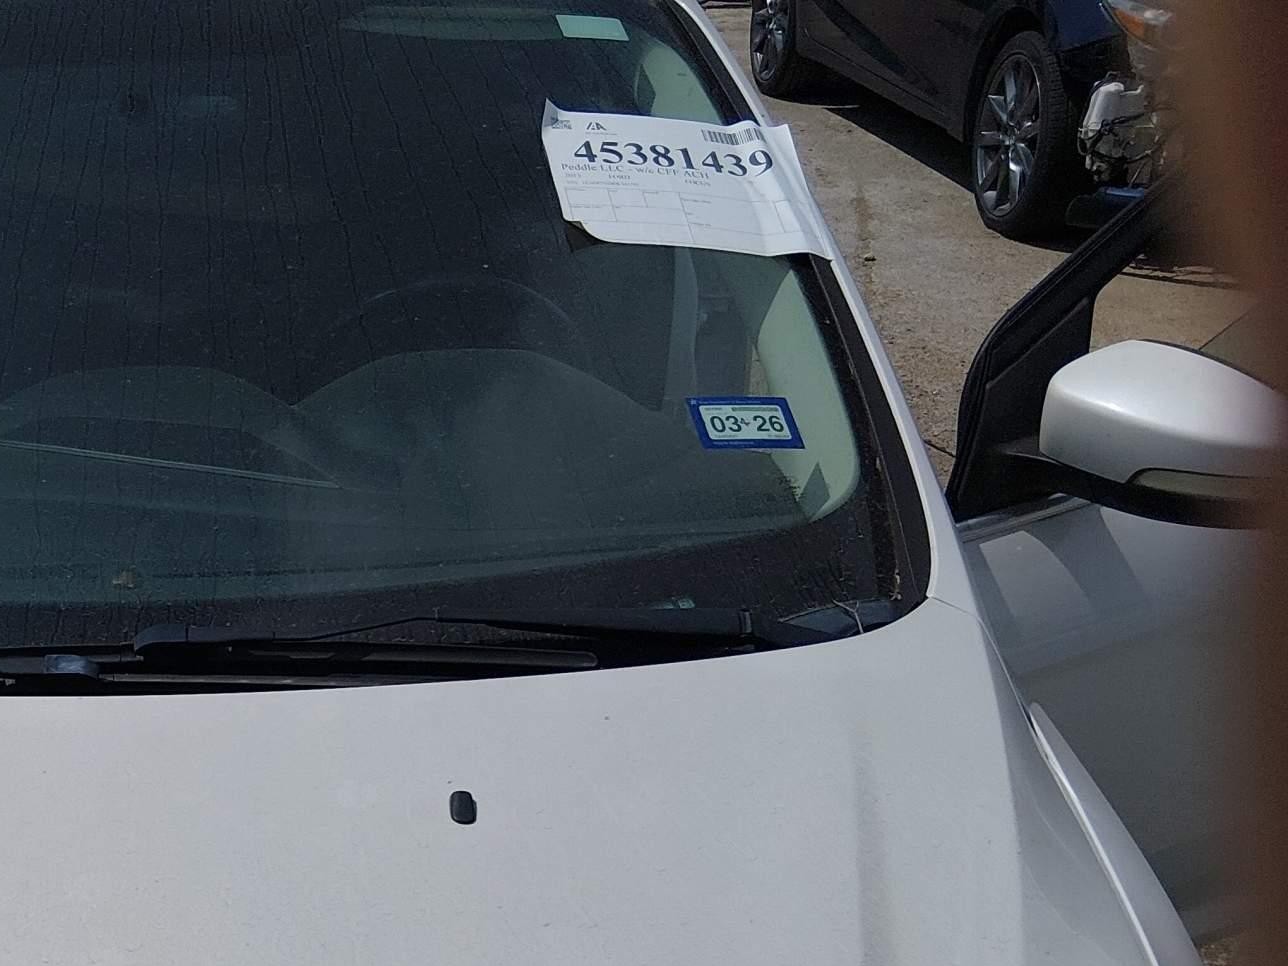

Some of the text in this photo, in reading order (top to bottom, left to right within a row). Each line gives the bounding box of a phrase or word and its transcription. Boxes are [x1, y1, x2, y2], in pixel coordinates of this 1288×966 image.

[574, 140, 773, 178] 45381439
[600, 164, 624, 172] LLC
[710, 415, 785, 433] 03 26
